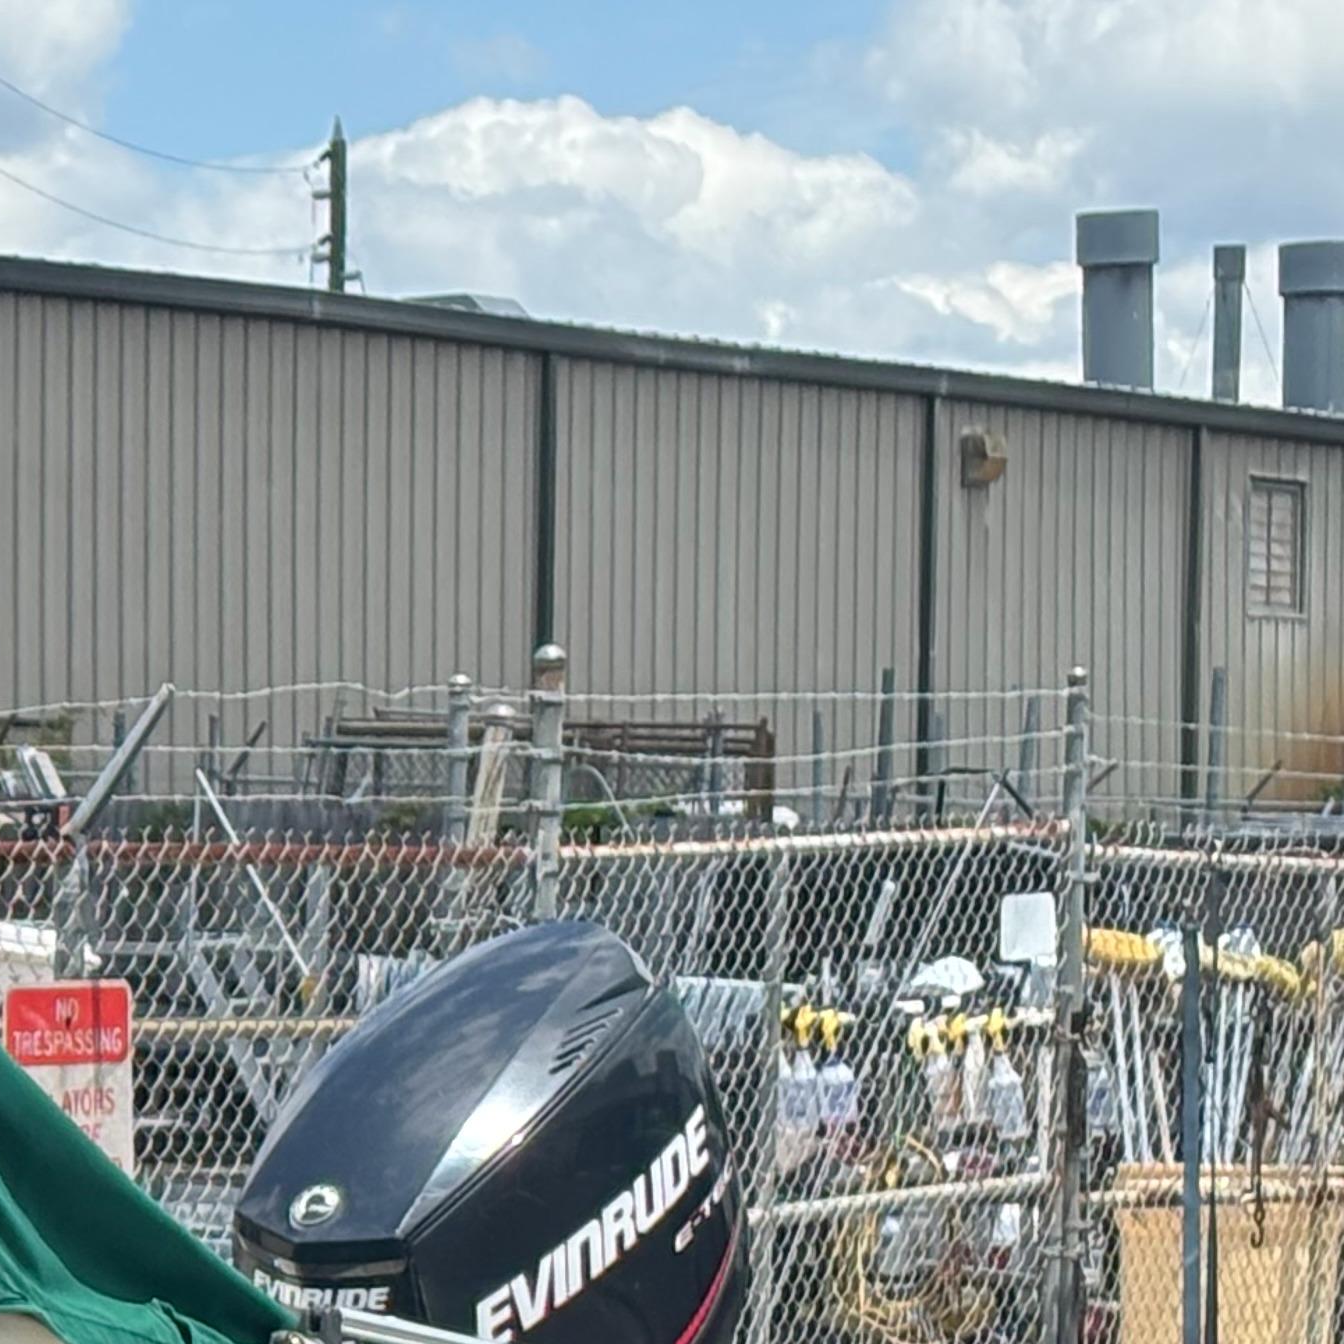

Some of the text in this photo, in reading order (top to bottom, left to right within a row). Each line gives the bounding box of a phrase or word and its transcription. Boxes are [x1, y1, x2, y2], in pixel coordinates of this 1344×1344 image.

[55, 997, 80, 1025] NO
[13, 1027, 123, 1057] TRESPASSING
[62, 1087, 116, 1116] ATORS
[476, 1104, 710, 1344] EVINRUDE
